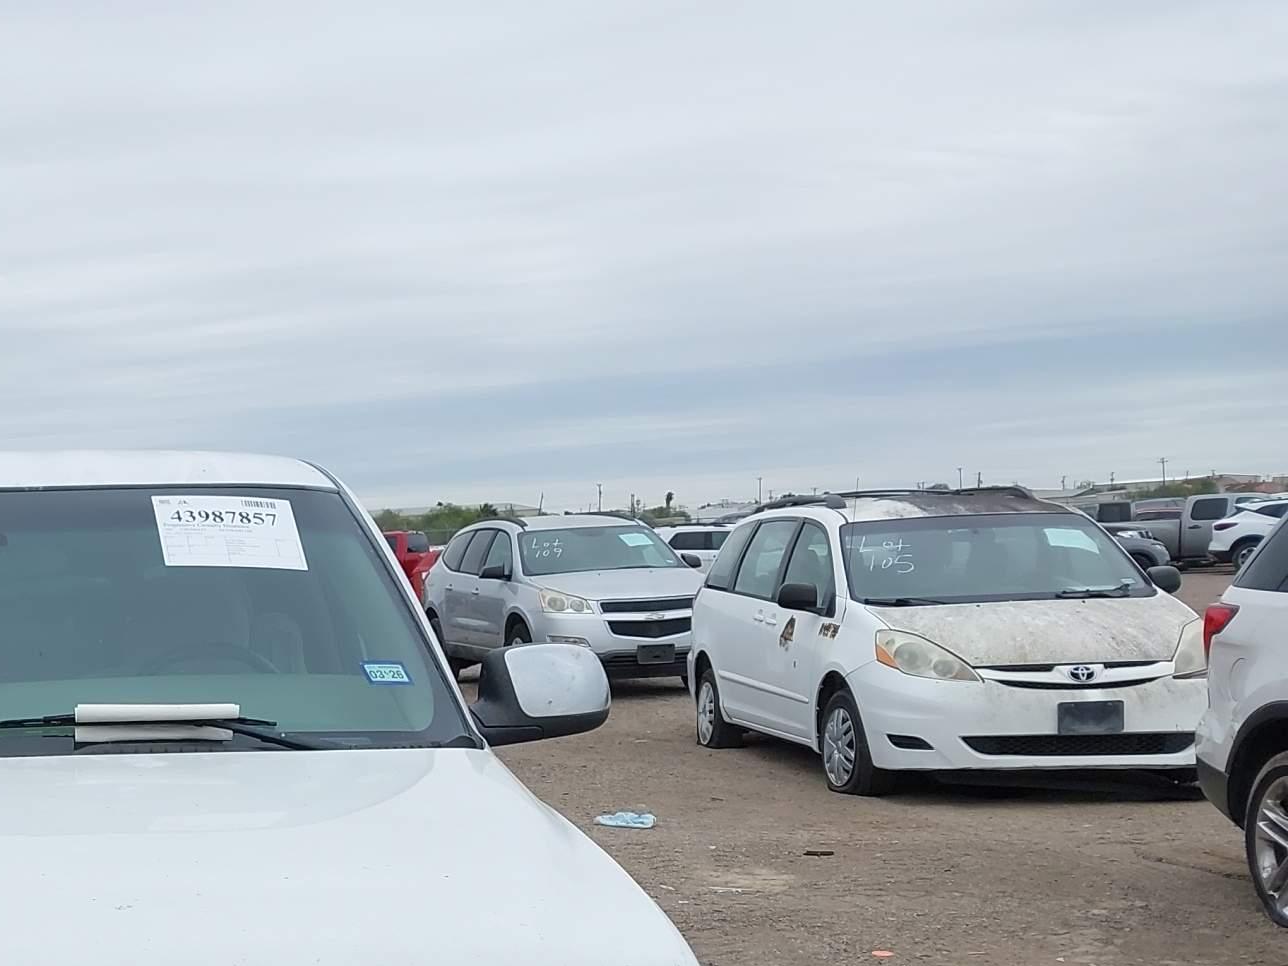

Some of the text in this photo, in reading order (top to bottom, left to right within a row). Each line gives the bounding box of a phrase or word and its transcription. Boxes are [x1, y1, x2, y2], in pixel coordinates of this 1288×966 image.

[170, 509, 277, 527] 43987857
[535, 547, 563, 558] 109
[869, 554, 915, 573] 105
